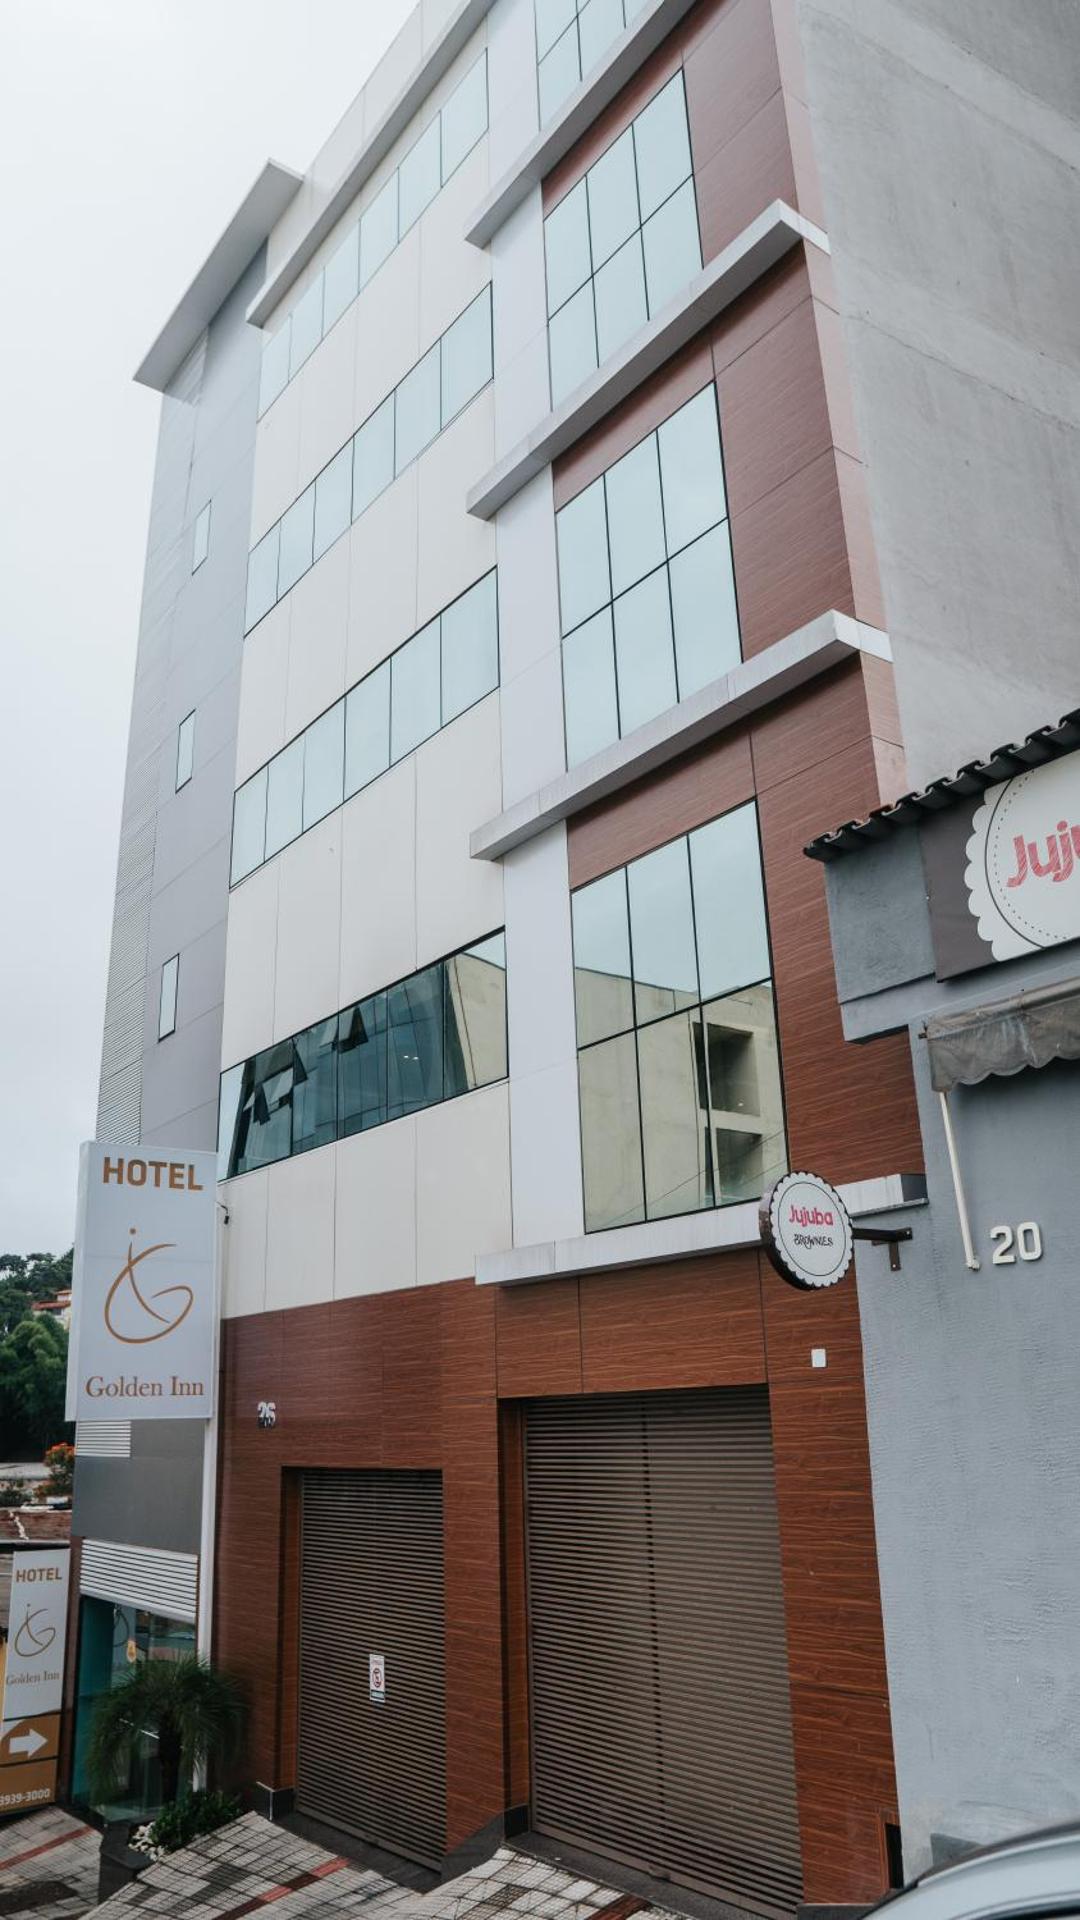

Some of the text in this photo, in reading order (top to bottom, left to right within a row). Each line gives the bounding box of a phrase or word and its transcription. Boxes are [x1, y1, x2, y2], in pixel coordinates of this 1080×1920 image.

[102, 1156, 203, 1190] HOTEL
[789, 1204, 834, 1227] Jujuba
[794, 1233, 834, 1249] BROWNIES
[990, 1221, 1043, 1265] 20
[85, 1375, 204, 1397] Golden Inn
[15, 1568, 62, 1582] HOTEL
[6, 1670, 60, 1685] Golden Inn
